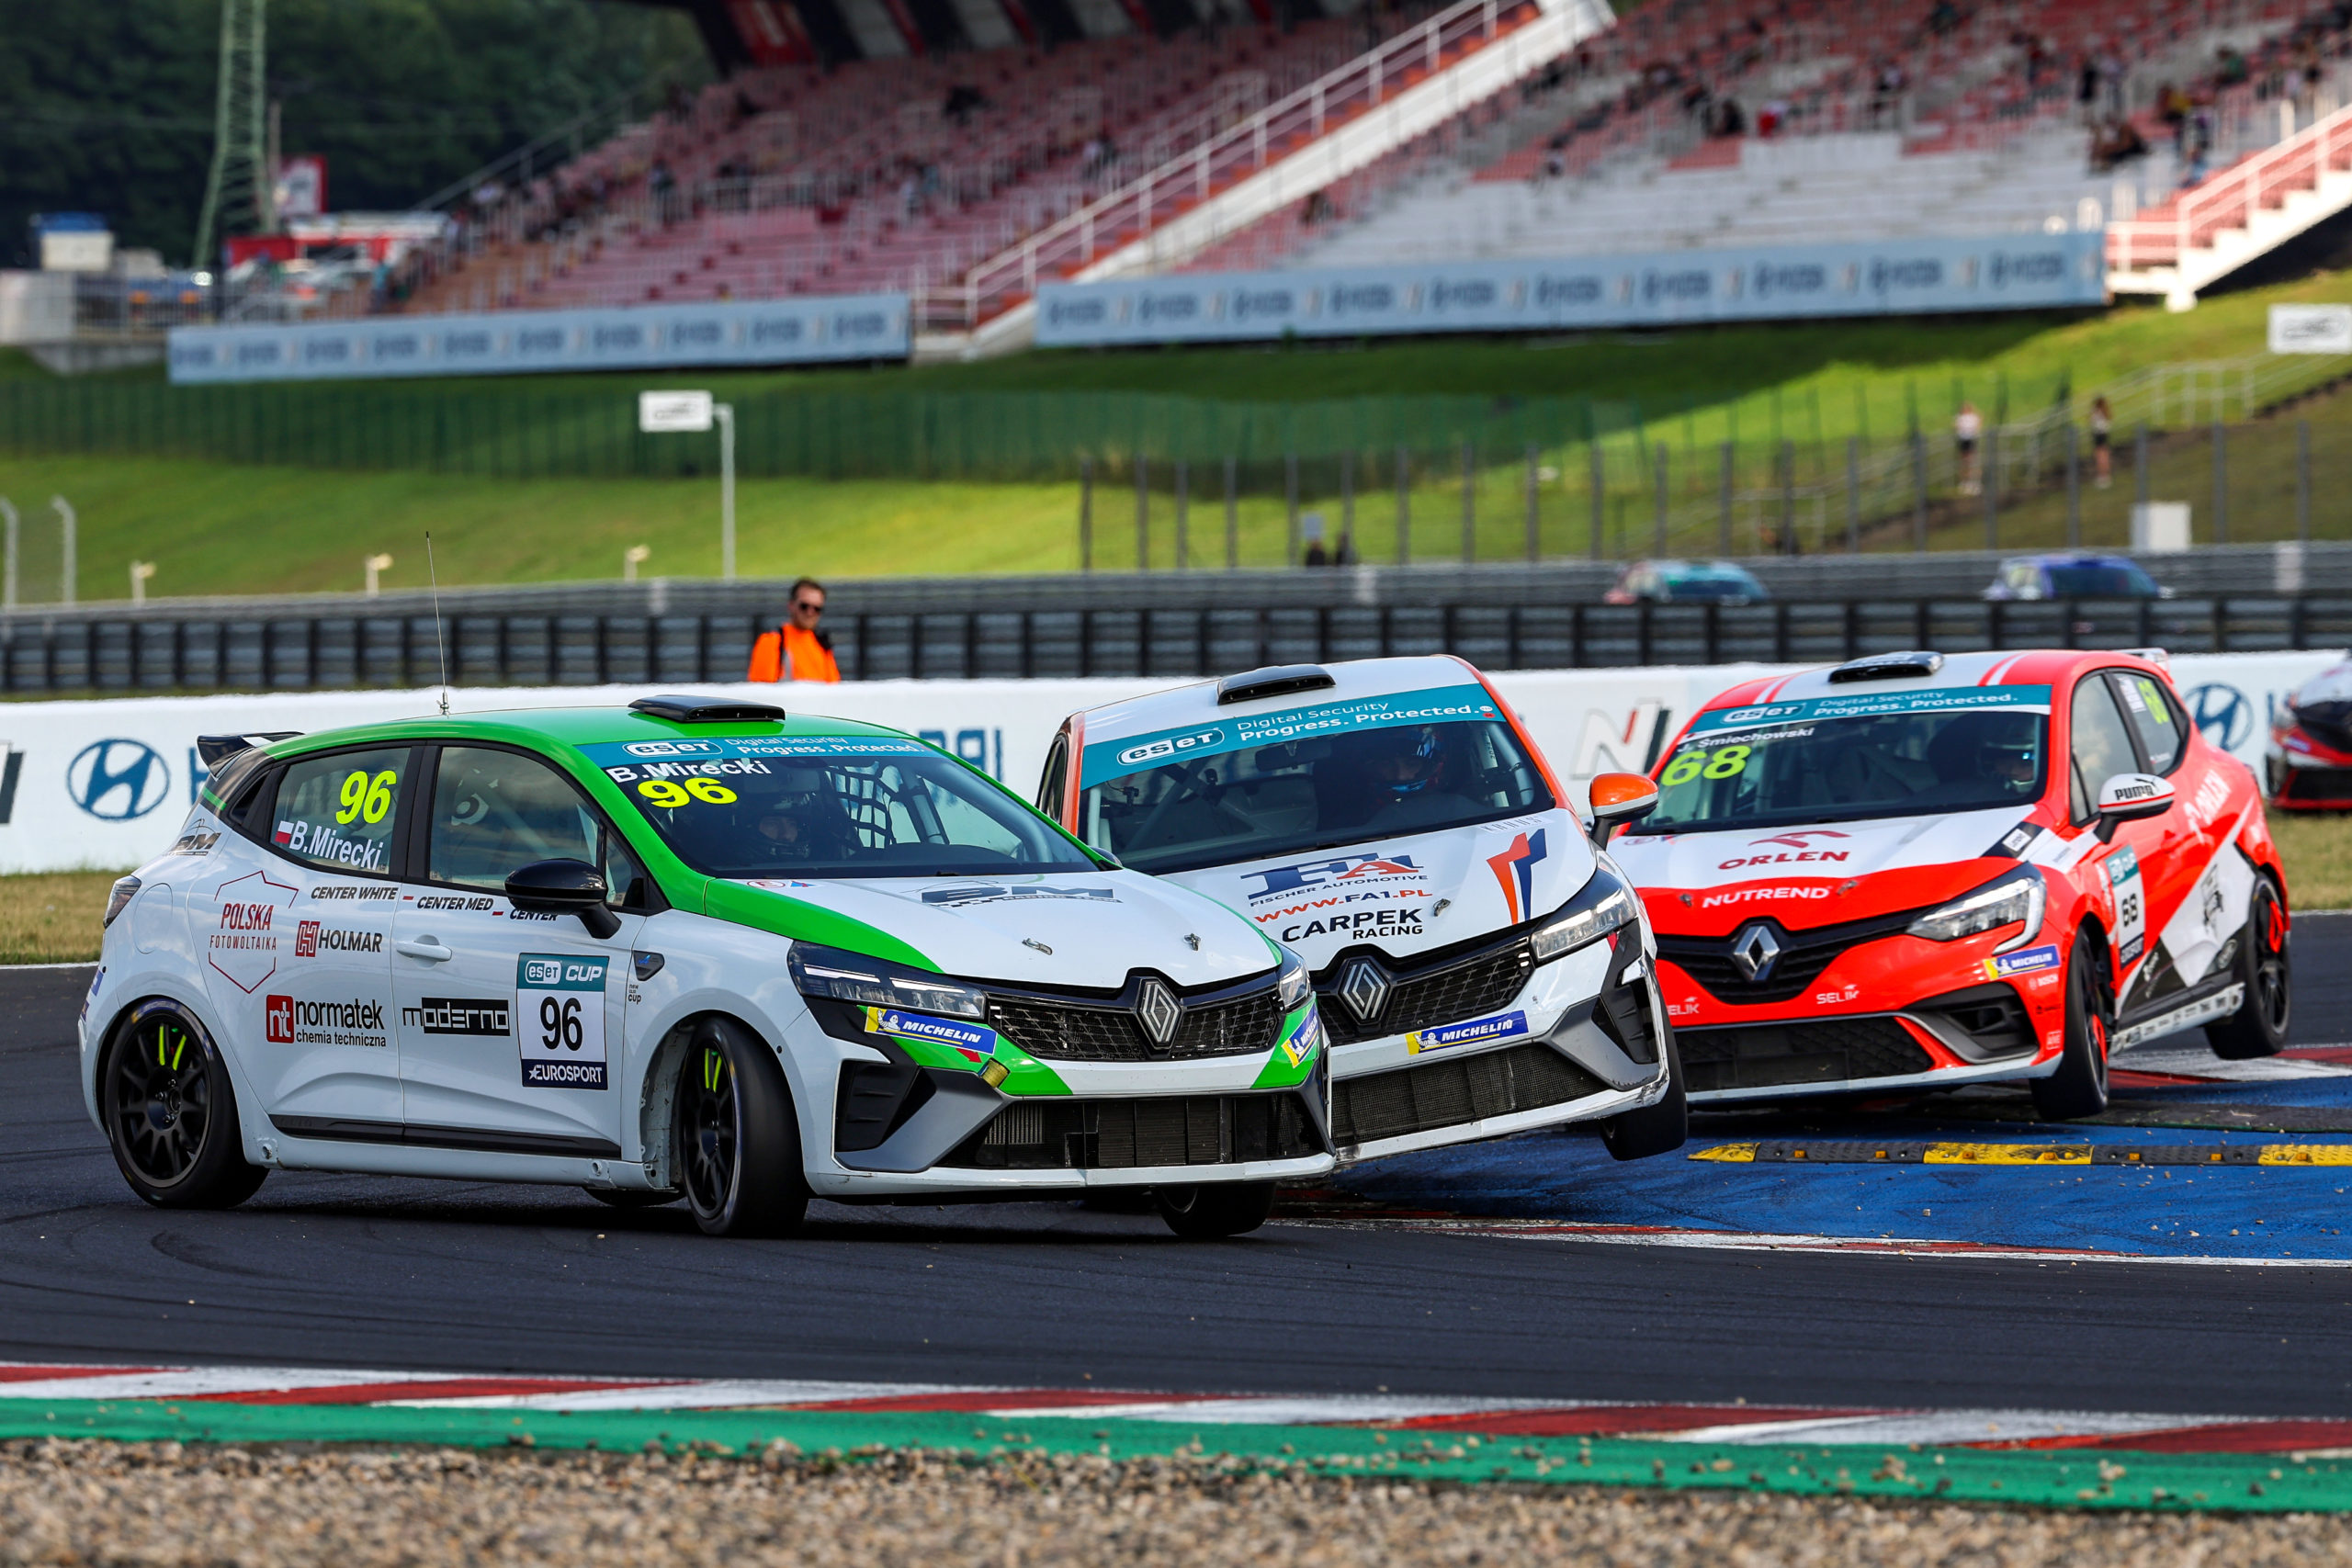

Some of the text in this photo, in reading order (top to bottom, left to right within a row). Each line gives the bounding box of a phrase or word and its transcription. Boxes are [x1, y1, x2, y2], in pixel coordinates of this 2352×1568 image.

[1813, 693, 2018, 716] Progress. Protected.
[1819, 691, 1945, 707] Digital Security
[1237, 700, 1390, 732] Digital Security
[1240, 704, 1480, 742] Progress. Protected.
[725, 736, 847, 747] Digital Security
[737, 743, 923, 756] Progress. Protected.
[606, 761, 773, 784] B.Mirecki
[1659, 745, 1751, 787] 68
[335, 770, 396, 825] 96
[638, 777, 738, 808] 96
[2115, 785, 2154, 800] PUMA
[288, 820, 384, 871] B.Mirecki
[1717, 851, 1851, 870] ORLEN
[311, 886, 399, 900] CENTER WHITE
[1250, 874, 1429, 908] FISCHER AUTOMOTIVE
[1702, 887, 1830, 908] NUTREND
[416, 897, 494, 912] CENTER MED
[220, 903, 275, 931] POLSKA
[1282, 908, 1423, 942] CARPEK
[209, 934, 277, 951] FOTOWOLTAIKA
[319, 929, 383, 953] HOLMAR
[1352, 925, 1424, 940] RACING
[565, 964, 603, 982] CUP
[1816, 990, 1860, 1004] SELIK
[295, 998, 385, 1030] normatek
[1666, 1003, 1700, 1016] ELIK
[539, 996, 583, 1052] 96
[902, 1021, 982, 1043] MICHELIN
[1441, 1019, 1514, 1043] MICHELIN
[296, 1028, 387, 1047] chemia techniczna
[535, 1064, 603, 1083] EUROSPORT
